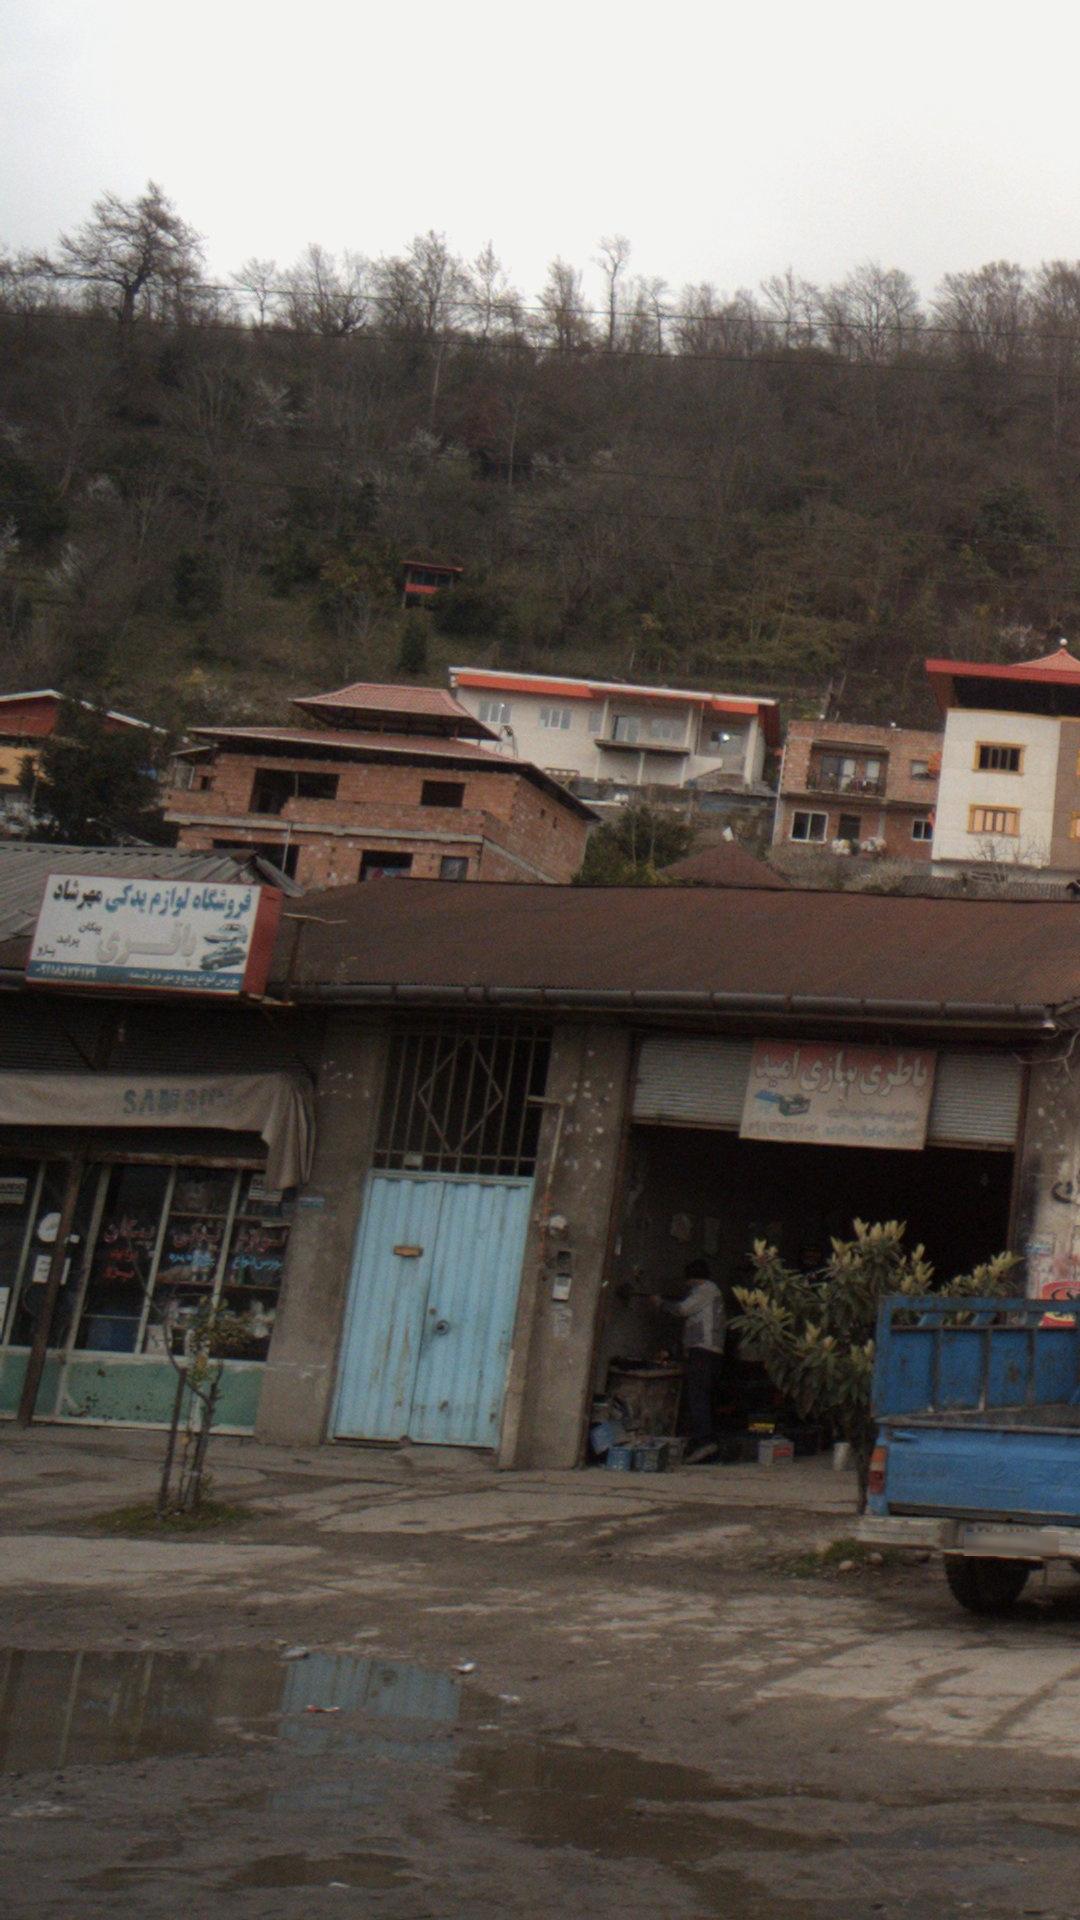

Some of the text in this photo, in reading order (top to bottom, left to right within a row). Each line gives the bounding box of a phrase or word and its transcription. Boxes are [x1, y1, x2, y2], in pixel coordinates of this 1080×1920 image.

[105, 883, 148, 913] یدکی
[149, 885, 190, 916] لوازم
[192, 885, 253, 919] فروشگاه
[755, 1048, 800, 1088] امید
[859, 1054, 928, 1097] باطری
